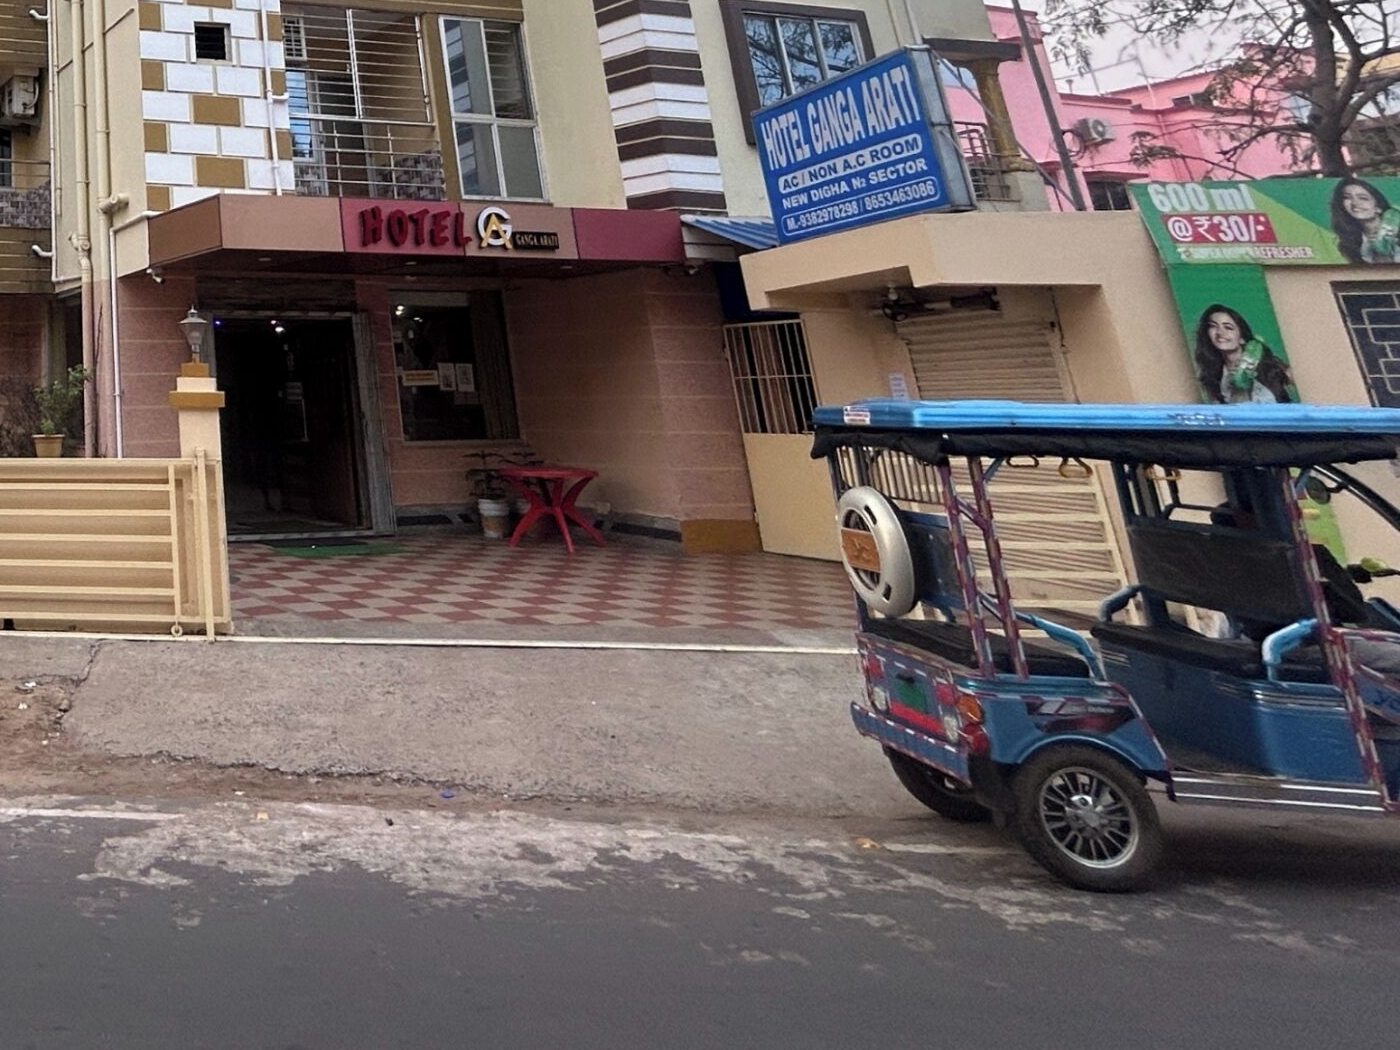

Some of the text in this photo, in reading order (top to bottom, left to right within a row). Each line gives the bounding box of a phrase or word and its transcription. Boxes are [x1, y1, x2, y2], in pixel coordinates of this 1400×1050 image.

[761, 65, 920, 170] HOTEL GANGA ARATI
[782, 176, 799, 191] AC
[808, 162, 838, 182] NON
[843, 154, 866, 172] A.C
[870, 137, 919, 163] ROOM
[782, 194, 808, 210] NEW
[810, 181, 850, 202] DIGHA
[869, 158, 928, 185] SECTOR
[1147, 182, 1256, 212] 600 ml
[359, 206, 473, 247] HOTEL
